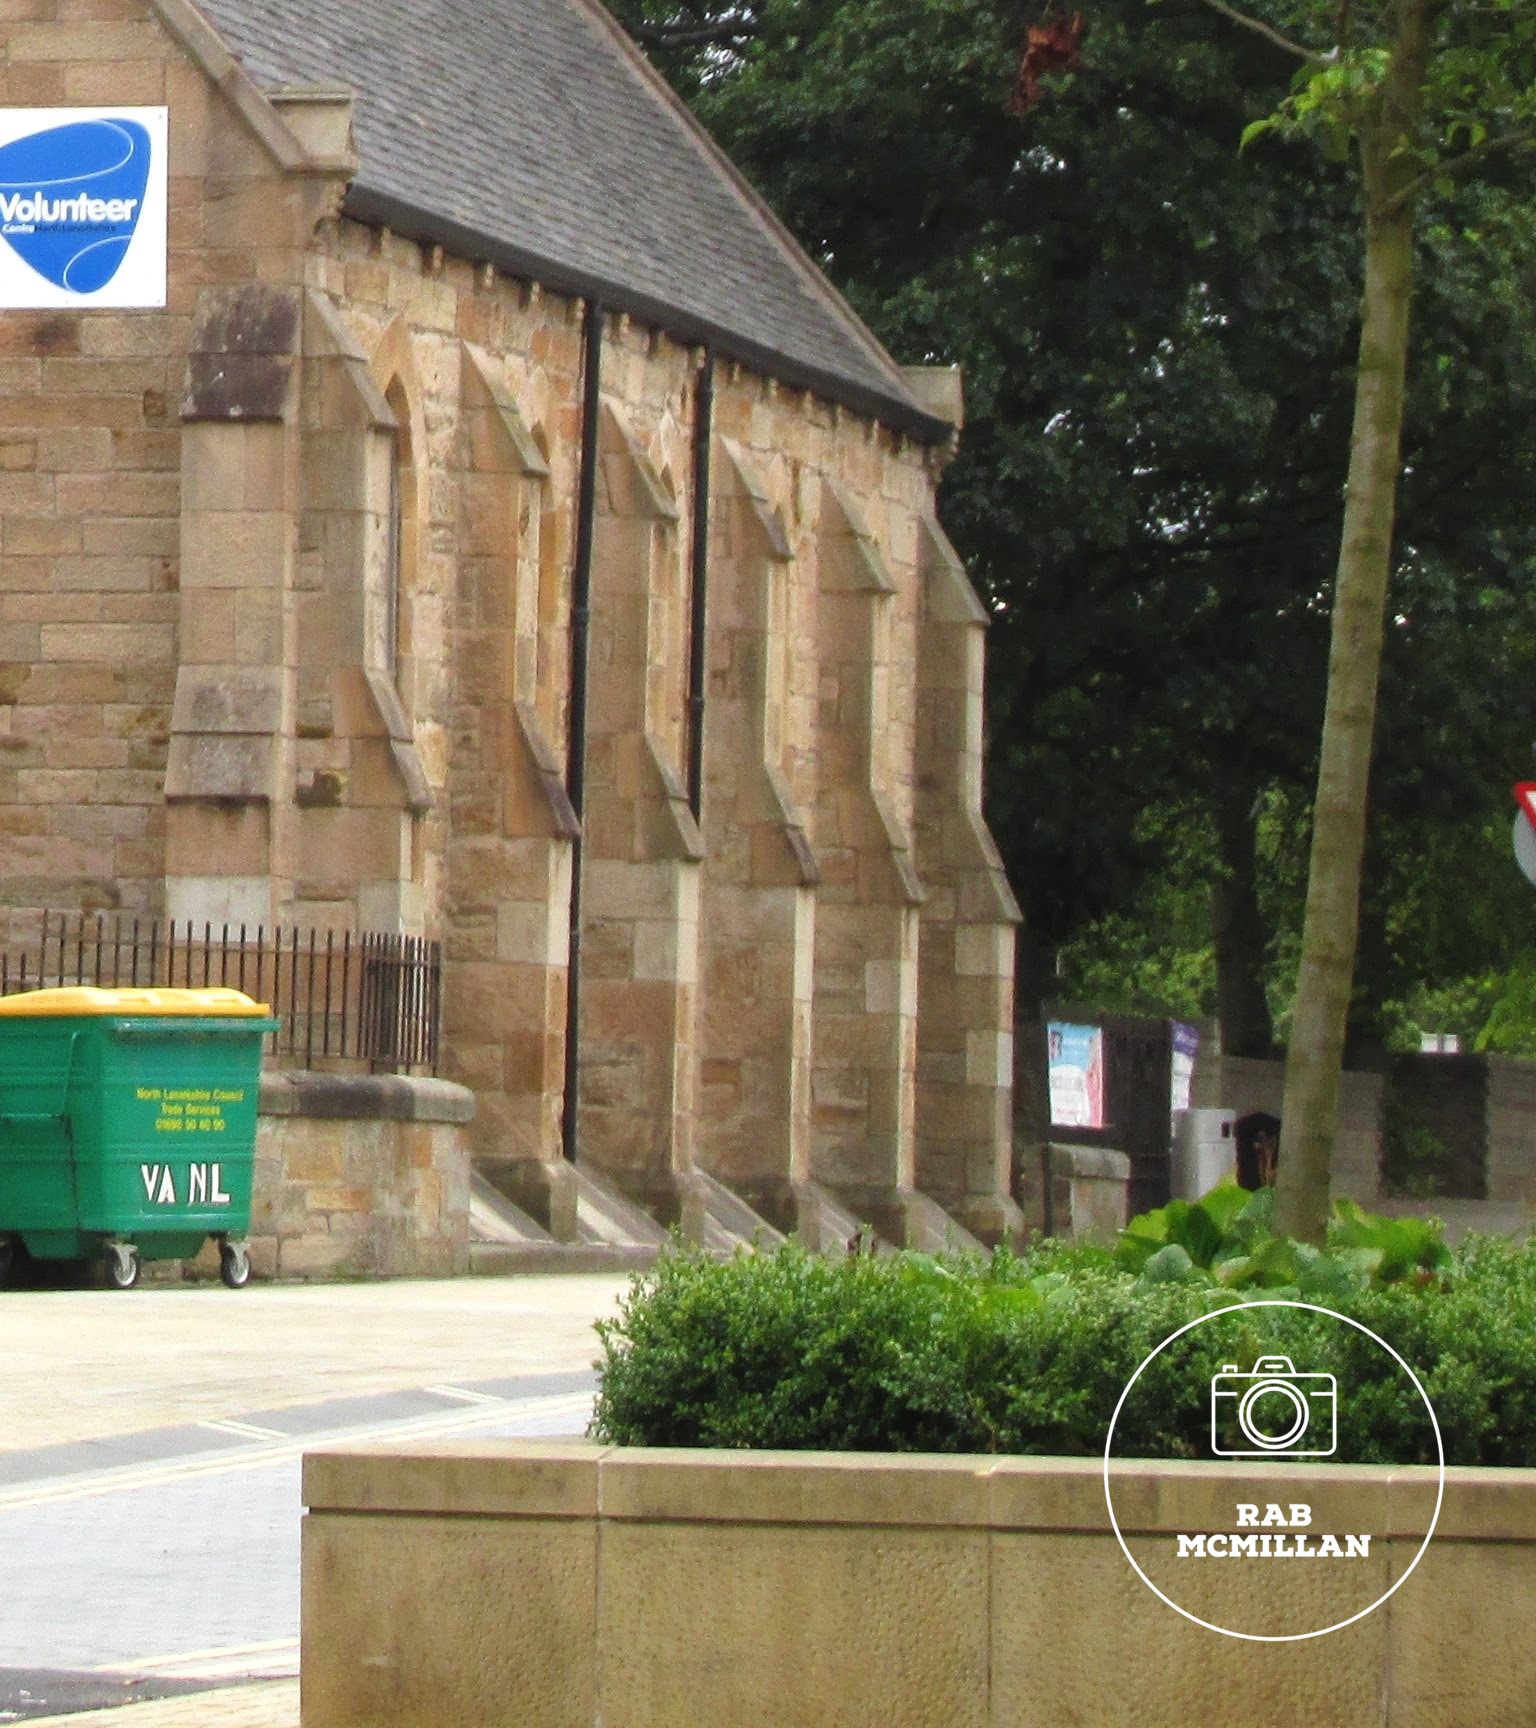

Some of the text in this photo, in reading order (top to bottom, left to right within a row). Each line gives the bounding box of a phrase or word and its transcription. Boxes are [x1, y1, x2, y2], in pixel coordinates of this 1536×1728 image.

[136, 1087, 161, 1100] North
[212, 1088, 245, 1101] Council
[161, 1102, 220, 1115] Trade Services
[140, 1162, 230, 1204] VA NL
